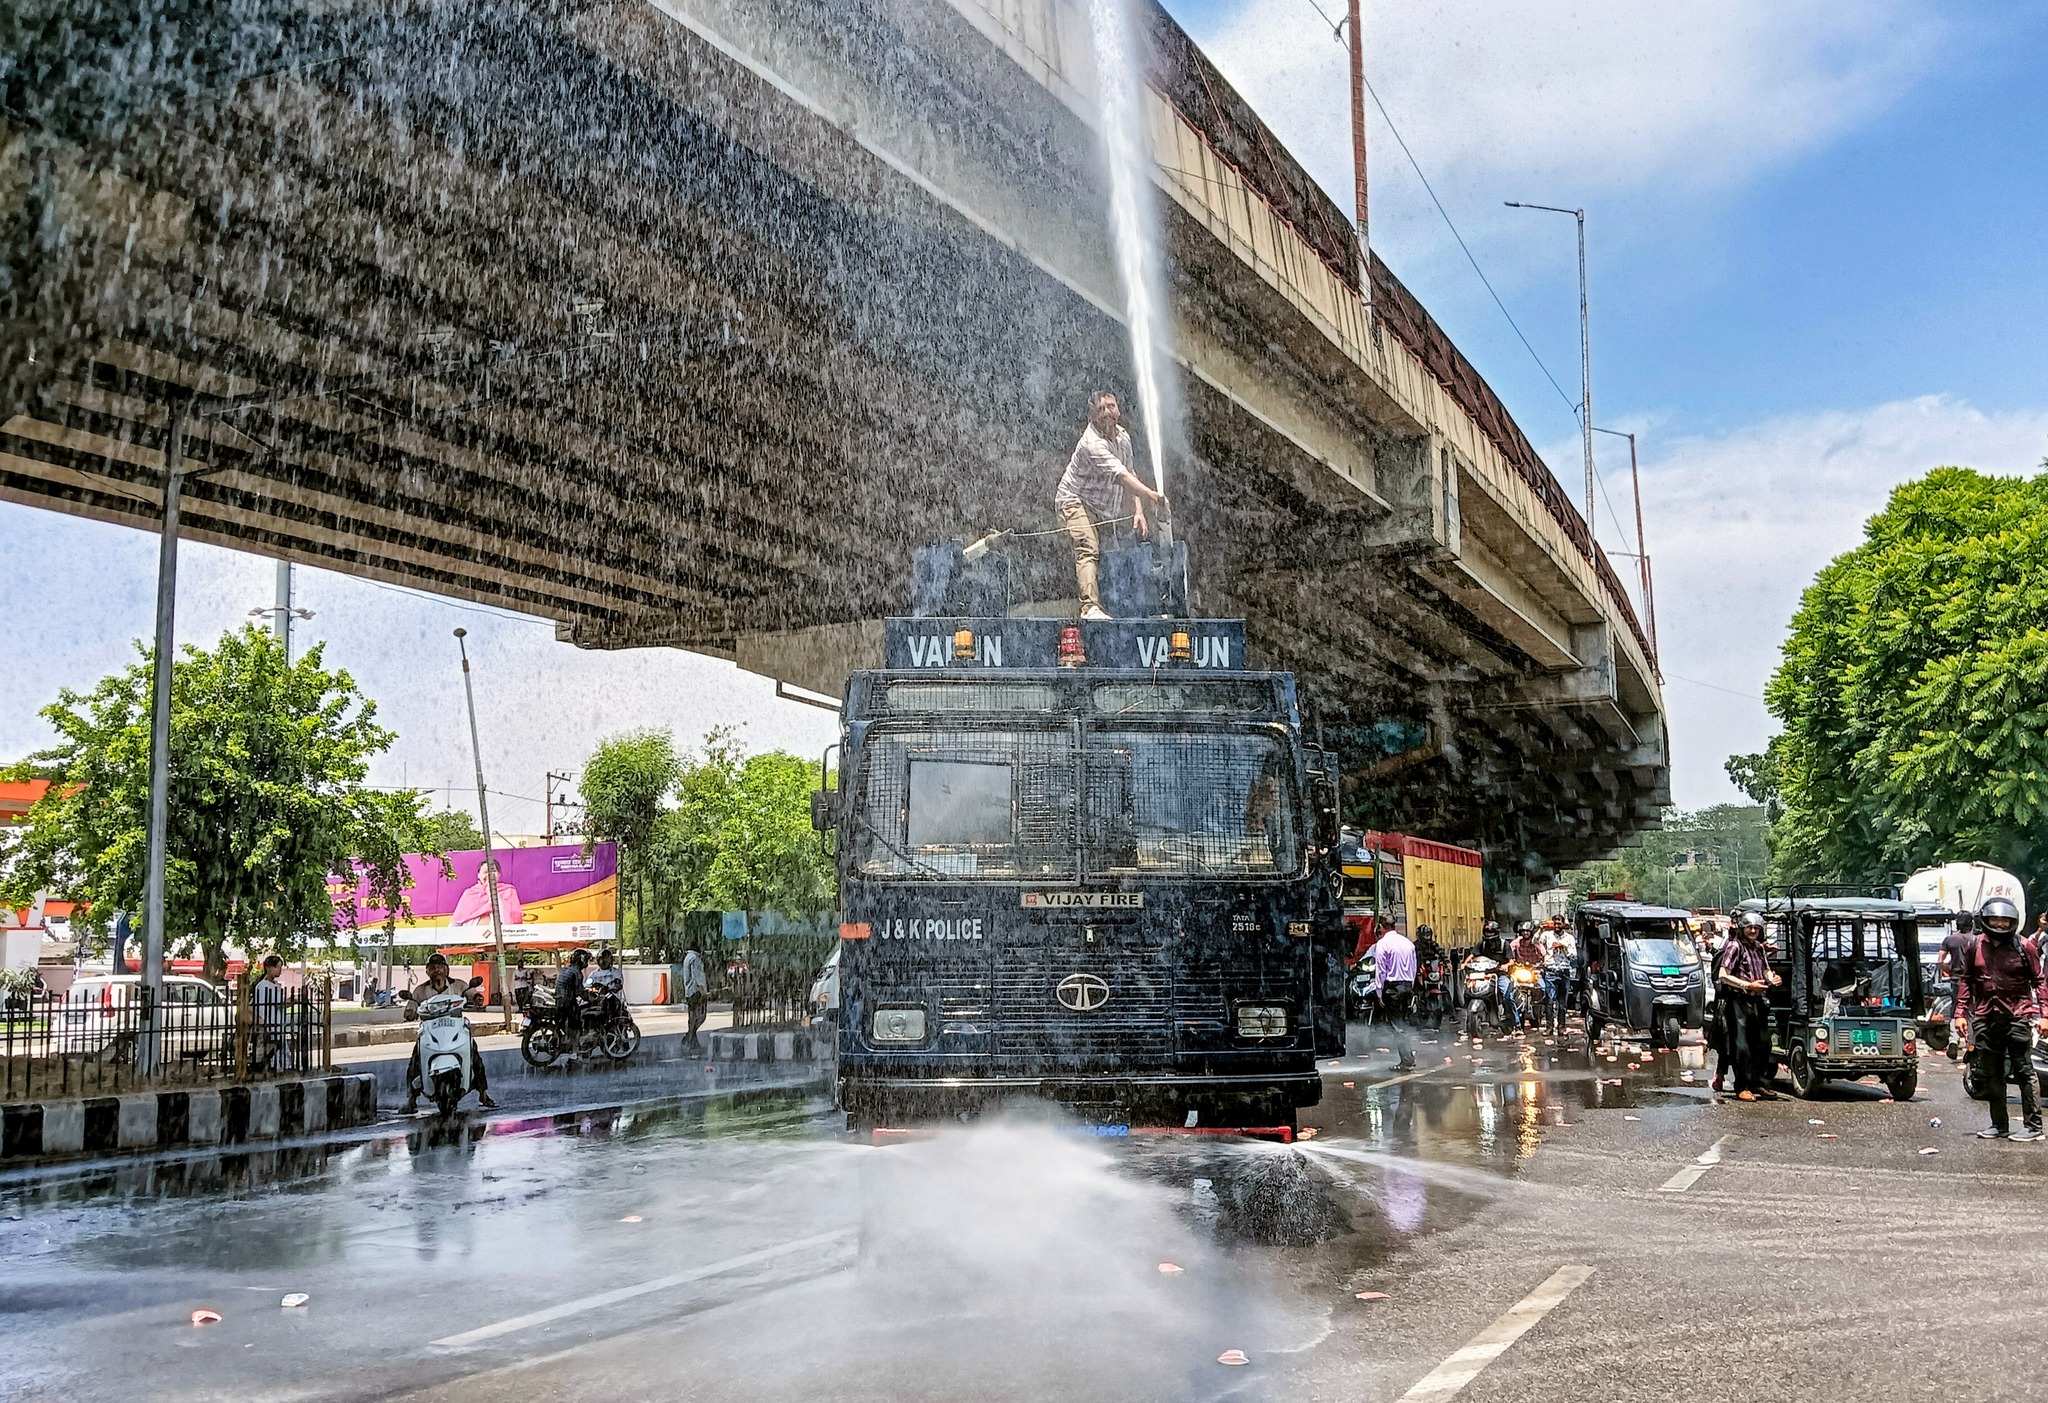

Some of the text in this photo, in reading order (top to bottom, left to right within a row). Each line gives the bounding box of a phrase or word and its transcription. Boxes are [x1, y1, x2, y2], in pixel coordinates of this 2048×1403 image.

[1136, 636, 1230, 667] VAUN
[1044, 895, 1094, 905] VIJAY
[1100, 895, 1139, 905] FIRE
[925, 918, 983, 940] POLICE
